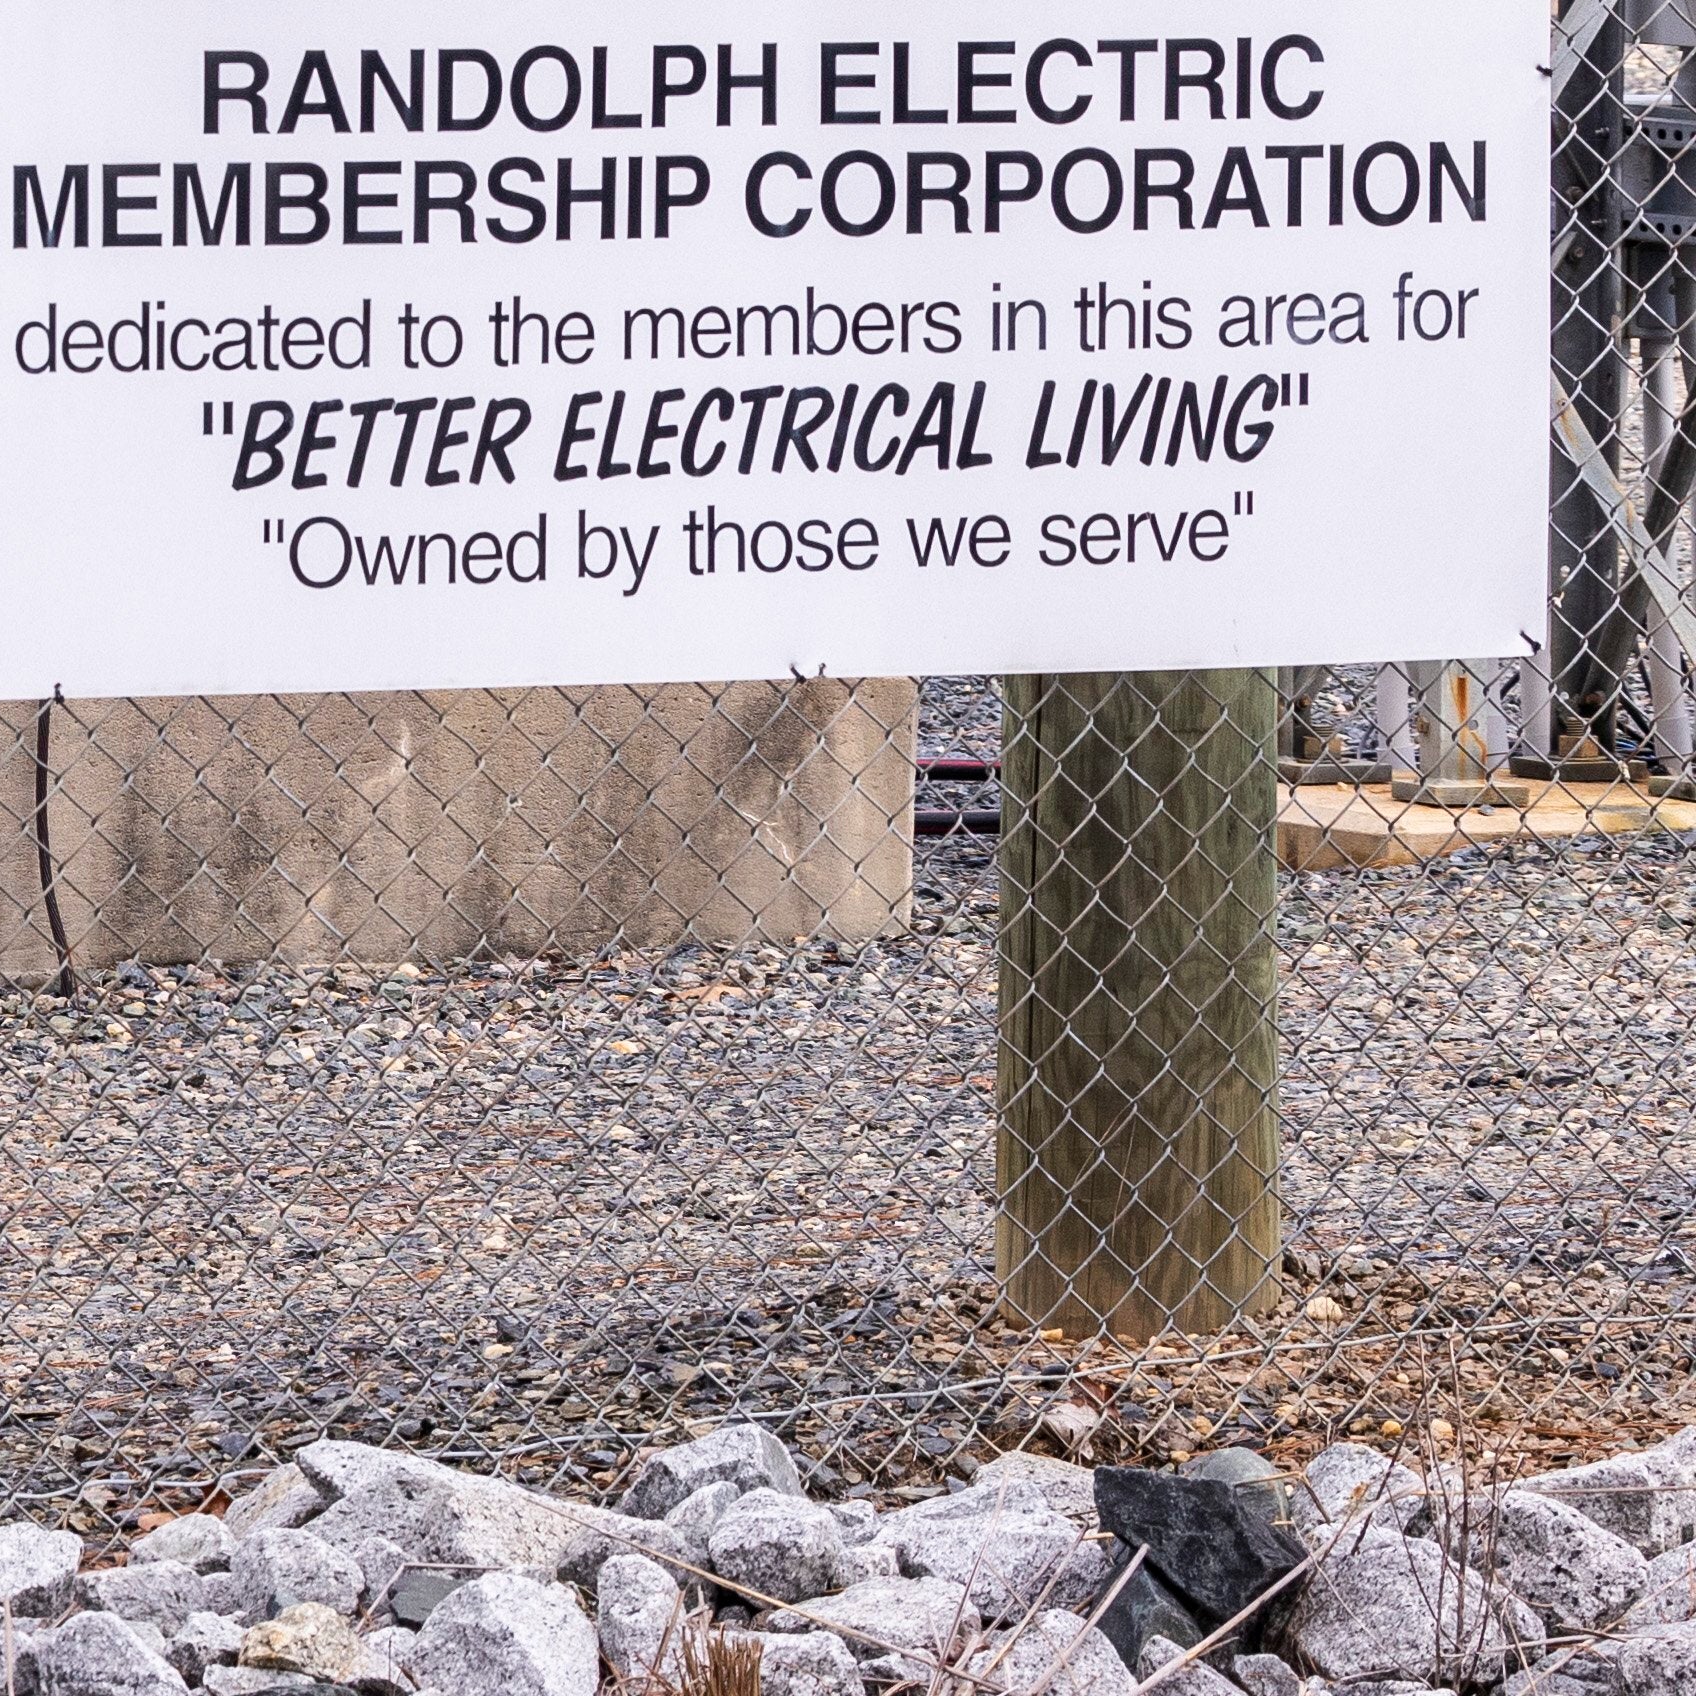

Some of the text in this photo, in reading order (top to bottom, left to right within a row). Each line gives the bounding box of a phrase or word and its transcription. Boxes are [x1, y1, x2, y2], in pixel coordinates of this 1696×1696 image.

[204, 34, 1324, 134] RANDOLPH ELECTRIC
[14, 141, 1486, 248] MEMBERSHIP CORPORATION
[16, 272, 1479, 374] dedicated to the members in this area for
[204, 373, 1308, 491] "BETTER ELECTRICAL LIVING"
[264, 491, 1253, 596] "Owned by those we serve"
